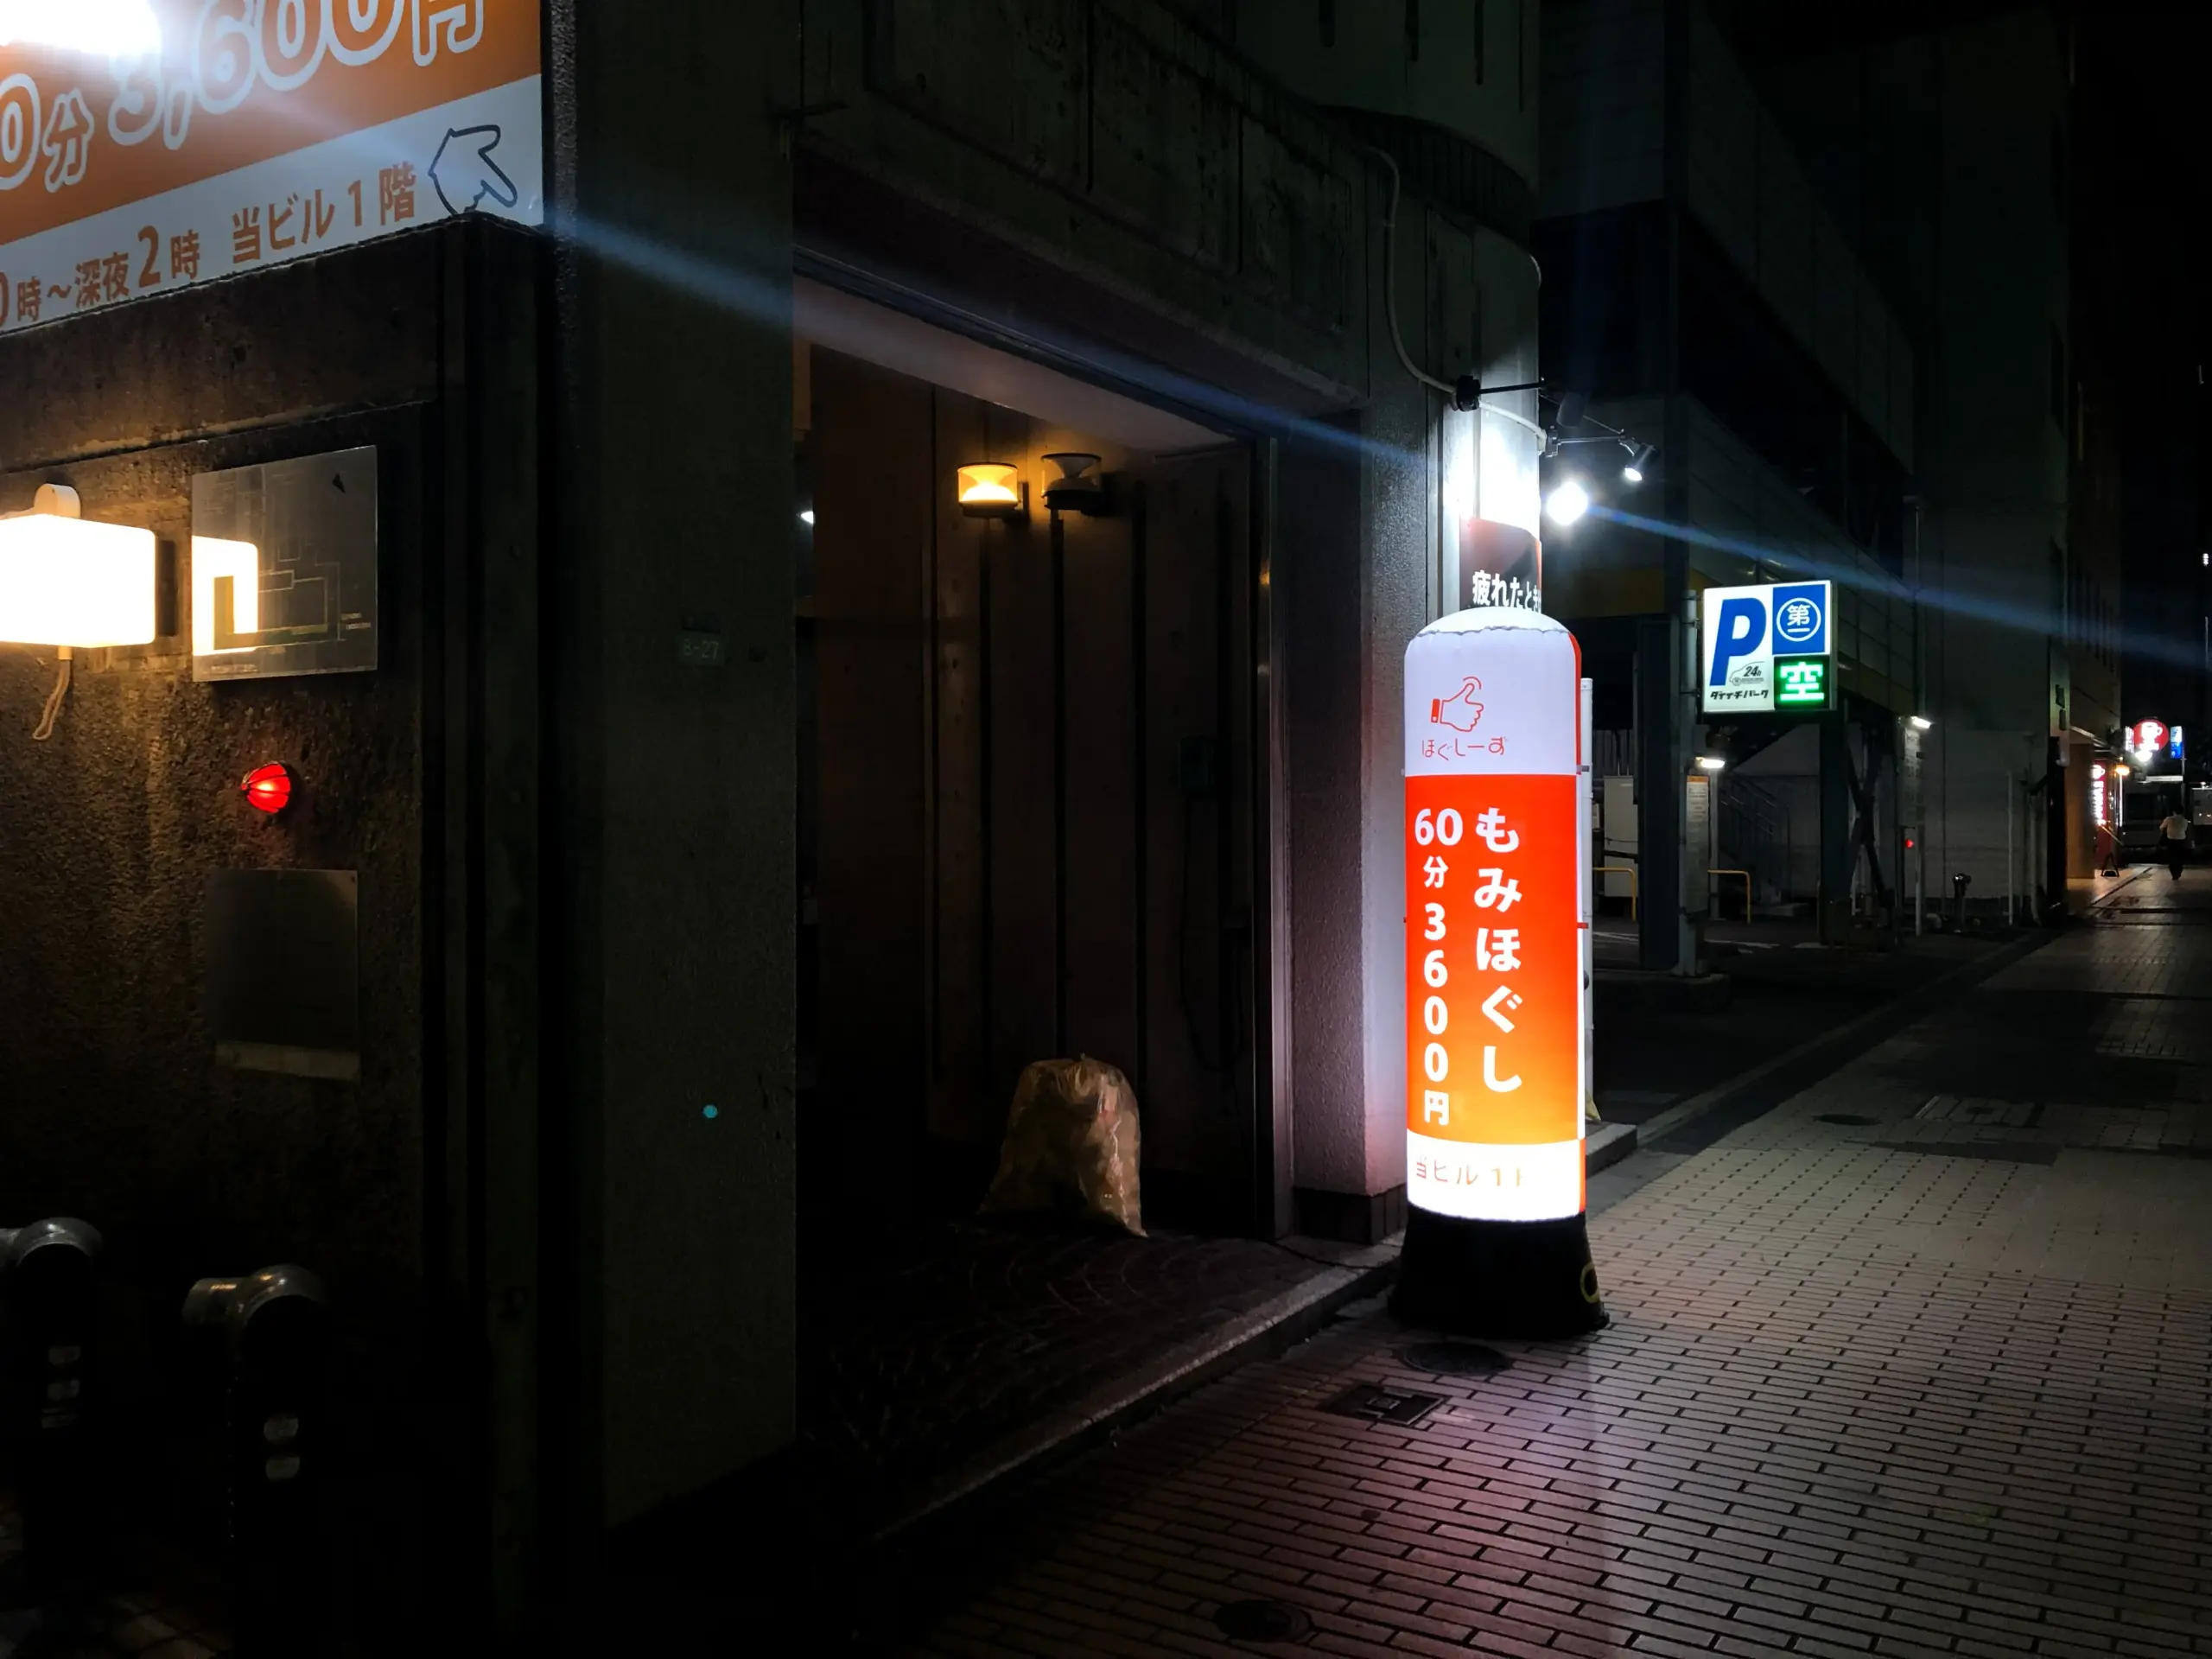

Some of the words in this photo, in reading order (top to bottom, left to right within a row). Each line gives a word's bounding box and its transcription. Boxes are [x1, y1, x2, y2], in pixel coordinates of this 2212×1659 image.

[0, 225, 201, 327] 時〜深夜2時
[1709, 598, 1767, 686] P
[1780, 662, 1825, 702] 空
[1474, 808, 1522, 1092] もみほぐし
